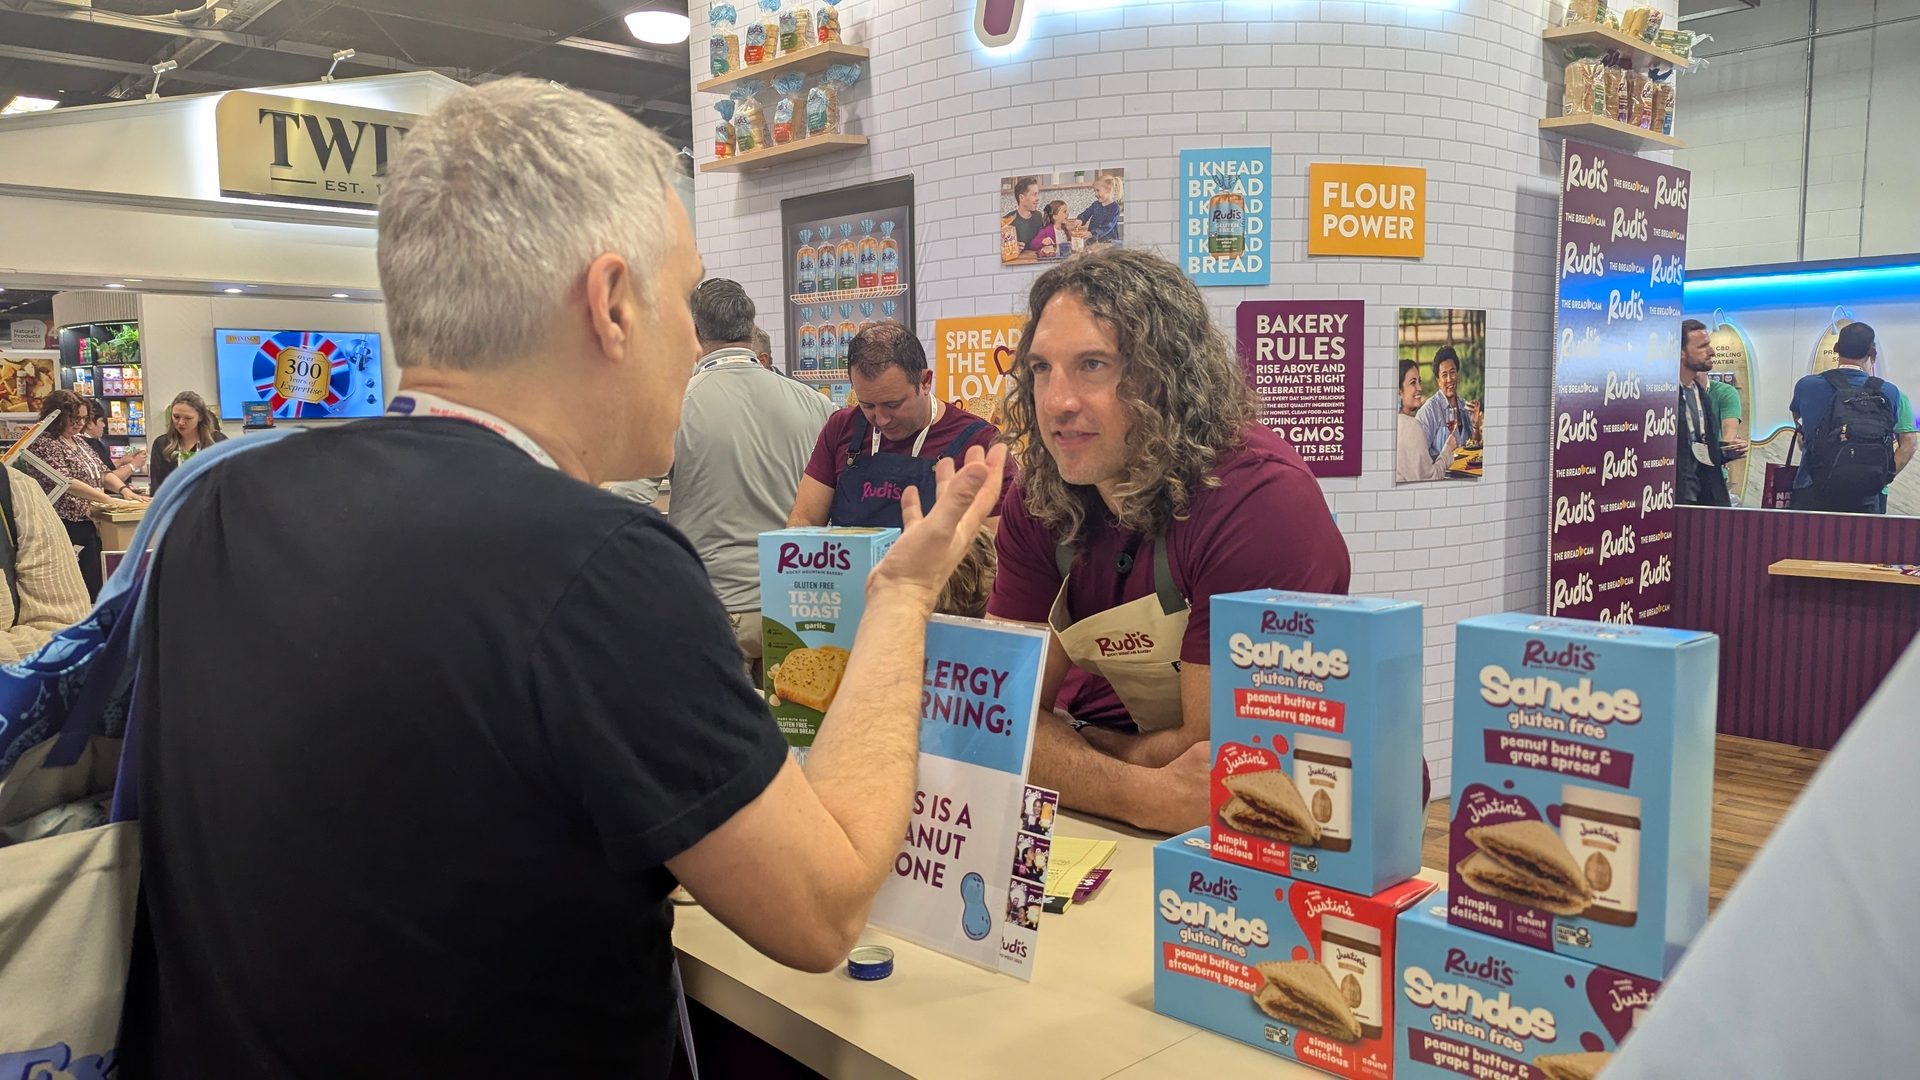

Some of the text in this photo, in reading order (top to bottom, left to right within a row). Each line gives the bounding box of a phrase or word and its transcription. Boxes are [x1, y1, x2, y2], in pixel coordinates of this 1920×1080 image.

[1189, 160, 1264, 176] I KNEAD
[1566, 154, 1609, 192] Rudi's
[325, 180, 365, 194] EST.
[1189, 178, 1264, 197] BRAD
[1324, 182, 1415, 210] FLOUR
[1654, 175, 1688, 210] Rudi's
[1212, 208, 1242, 222] Rudi's
[1324, 214, 1414, 239] POWER
[1565, 213, 1575, 222] THE
[1575, 214, 1590, 224] BREAD
[1611, 207, 1648, 242] Rudi's
[1188, 255, 1263, 274] BREAD
[1562, 241, 1604, 279] Rudi's
[1650, 254, 1683, 288] Rudi's
[1607, 289, 1644, 325] Rudi's
[1257, 314, 1348, 334] BAKERY
[945, 329, 1022, 350] SPREAD
[1257, 337, 1345, 361] RULES
[285, 359, 322, 379] 300
[947, 352, 986, 373] THE
[1257, 364, 1345, 373] RISE ABOVE AND
[280, 381, 322, 393] Expertise
[1257, 374, 1345, 384] DO WHAT'S RIGHT
[1604, 369, 1640, 406] Rudi's
[1298, 417, 1345, 425] ARTIFICIAL
[1556, 409, 1598, 450] Rudi's
[1643, 406, 1676, 443] Rudi's
[1289, 426, 1345, 442] GMOS
[1302, 445, 1317, 454] ITS
[1318, 444, 1345, 454] BEST,
[1556, 469, 1566, 478] THE
[1566, 468, 1580, 477] BREAD
[1602, 447, 1638, 487] Rudi's
[861, 480, 902, 502] Rudi's
[1641, 481, 1674, 519] Rudi's
[1554, 491, 1595, 534] Rudi's
[1554, 551, 1564, 561] THE
[1564, 549, 1579, 560] BREAD
[1599, 524, 1636, 566] Rudi's
[777, 541, 851, 574] Rudi's
[794, 581, 835, 589] GLUTEN FREE
[1639, 554, 1672, 595] Rudi's
[788, 591, 841, 605] TEXAS
[1553, 572, 1594, 617] Rudi's
[789, 605, 842, 619] TOAST
[1261, 610, 1315, 635] Rudi's
[804, 622, 827, 630] garlic
[1095, 632, 1155, 656] Rudi's
[1229, 632, 1350, 679] Sandos
[1522, 640, 1596, 671] Rudi's
[923, 658, 1009, 698] LERGY
[1251, 670, 1324, 692] gluten free
[1246, 693, 1328, 712] peanut butter &
[1479, 665, 1643, 724] Sandos
[921, 690, 1013, 736] RNING:
[1240, 704, 1336, 728] strawberry spread
[1508, 710, 1606, 739] gluten free
[1223, 750, 1268, 774] Justin's
[1500, 735, 1612, 765] peanut butter &
[1307, 765, 1338, 781] Justin's
[1510, 750, 1601, 776] grape spread
[931, 795, 952, 822] IS
[955, 803, 972, 829] A
[1467, 797, 1526, 823] Justin's
[904, 821, 966, 860] ANUT
[1218, 834, 1248, 849] simply
[1579, 823, 1621, 844] Justin's
[1213, 844, 1254, 860] delicious
[1262, 847, 1285, 857] count
[895, 851, 946, 888] ONE
[1188, 871, 1238, 901] Rudi's
[1304, 897, 1355, 918] Justin's
[1451, 905, 1504, 929] delicious
[1457, 895, 1497, 915] simply
[1526, 909, 1534, 918] 4
[1159, 889, 1269, 948] Sandos
[1517, 914, 1547, 929] count
[1001, 937, 1028, 958] udi's
[1180, 928, 1246, 957] gluten free
[1175, 948, 1249, 977] peanut butter &
[1336, 948, 1367, 968] Justin's
[1444, 948, 1514, 986] Rudi's
[1168, 958, 1256, 991] strawberry spread
[1403, 966, 1556, 1043] Sandos
[1308, 1036, 1343, 1054] simply
[1431, 1014, 1524, 1054] gluten free
[1303, 1046, 1349, 1068] delicious
[1362, 1058, 1387, 1070] count
[1370, 1052, 1376, 1060] 4
[1424, 1036, 1529, 1079] peanut butter &
[1433, 1052, 1470, 1070] grape
